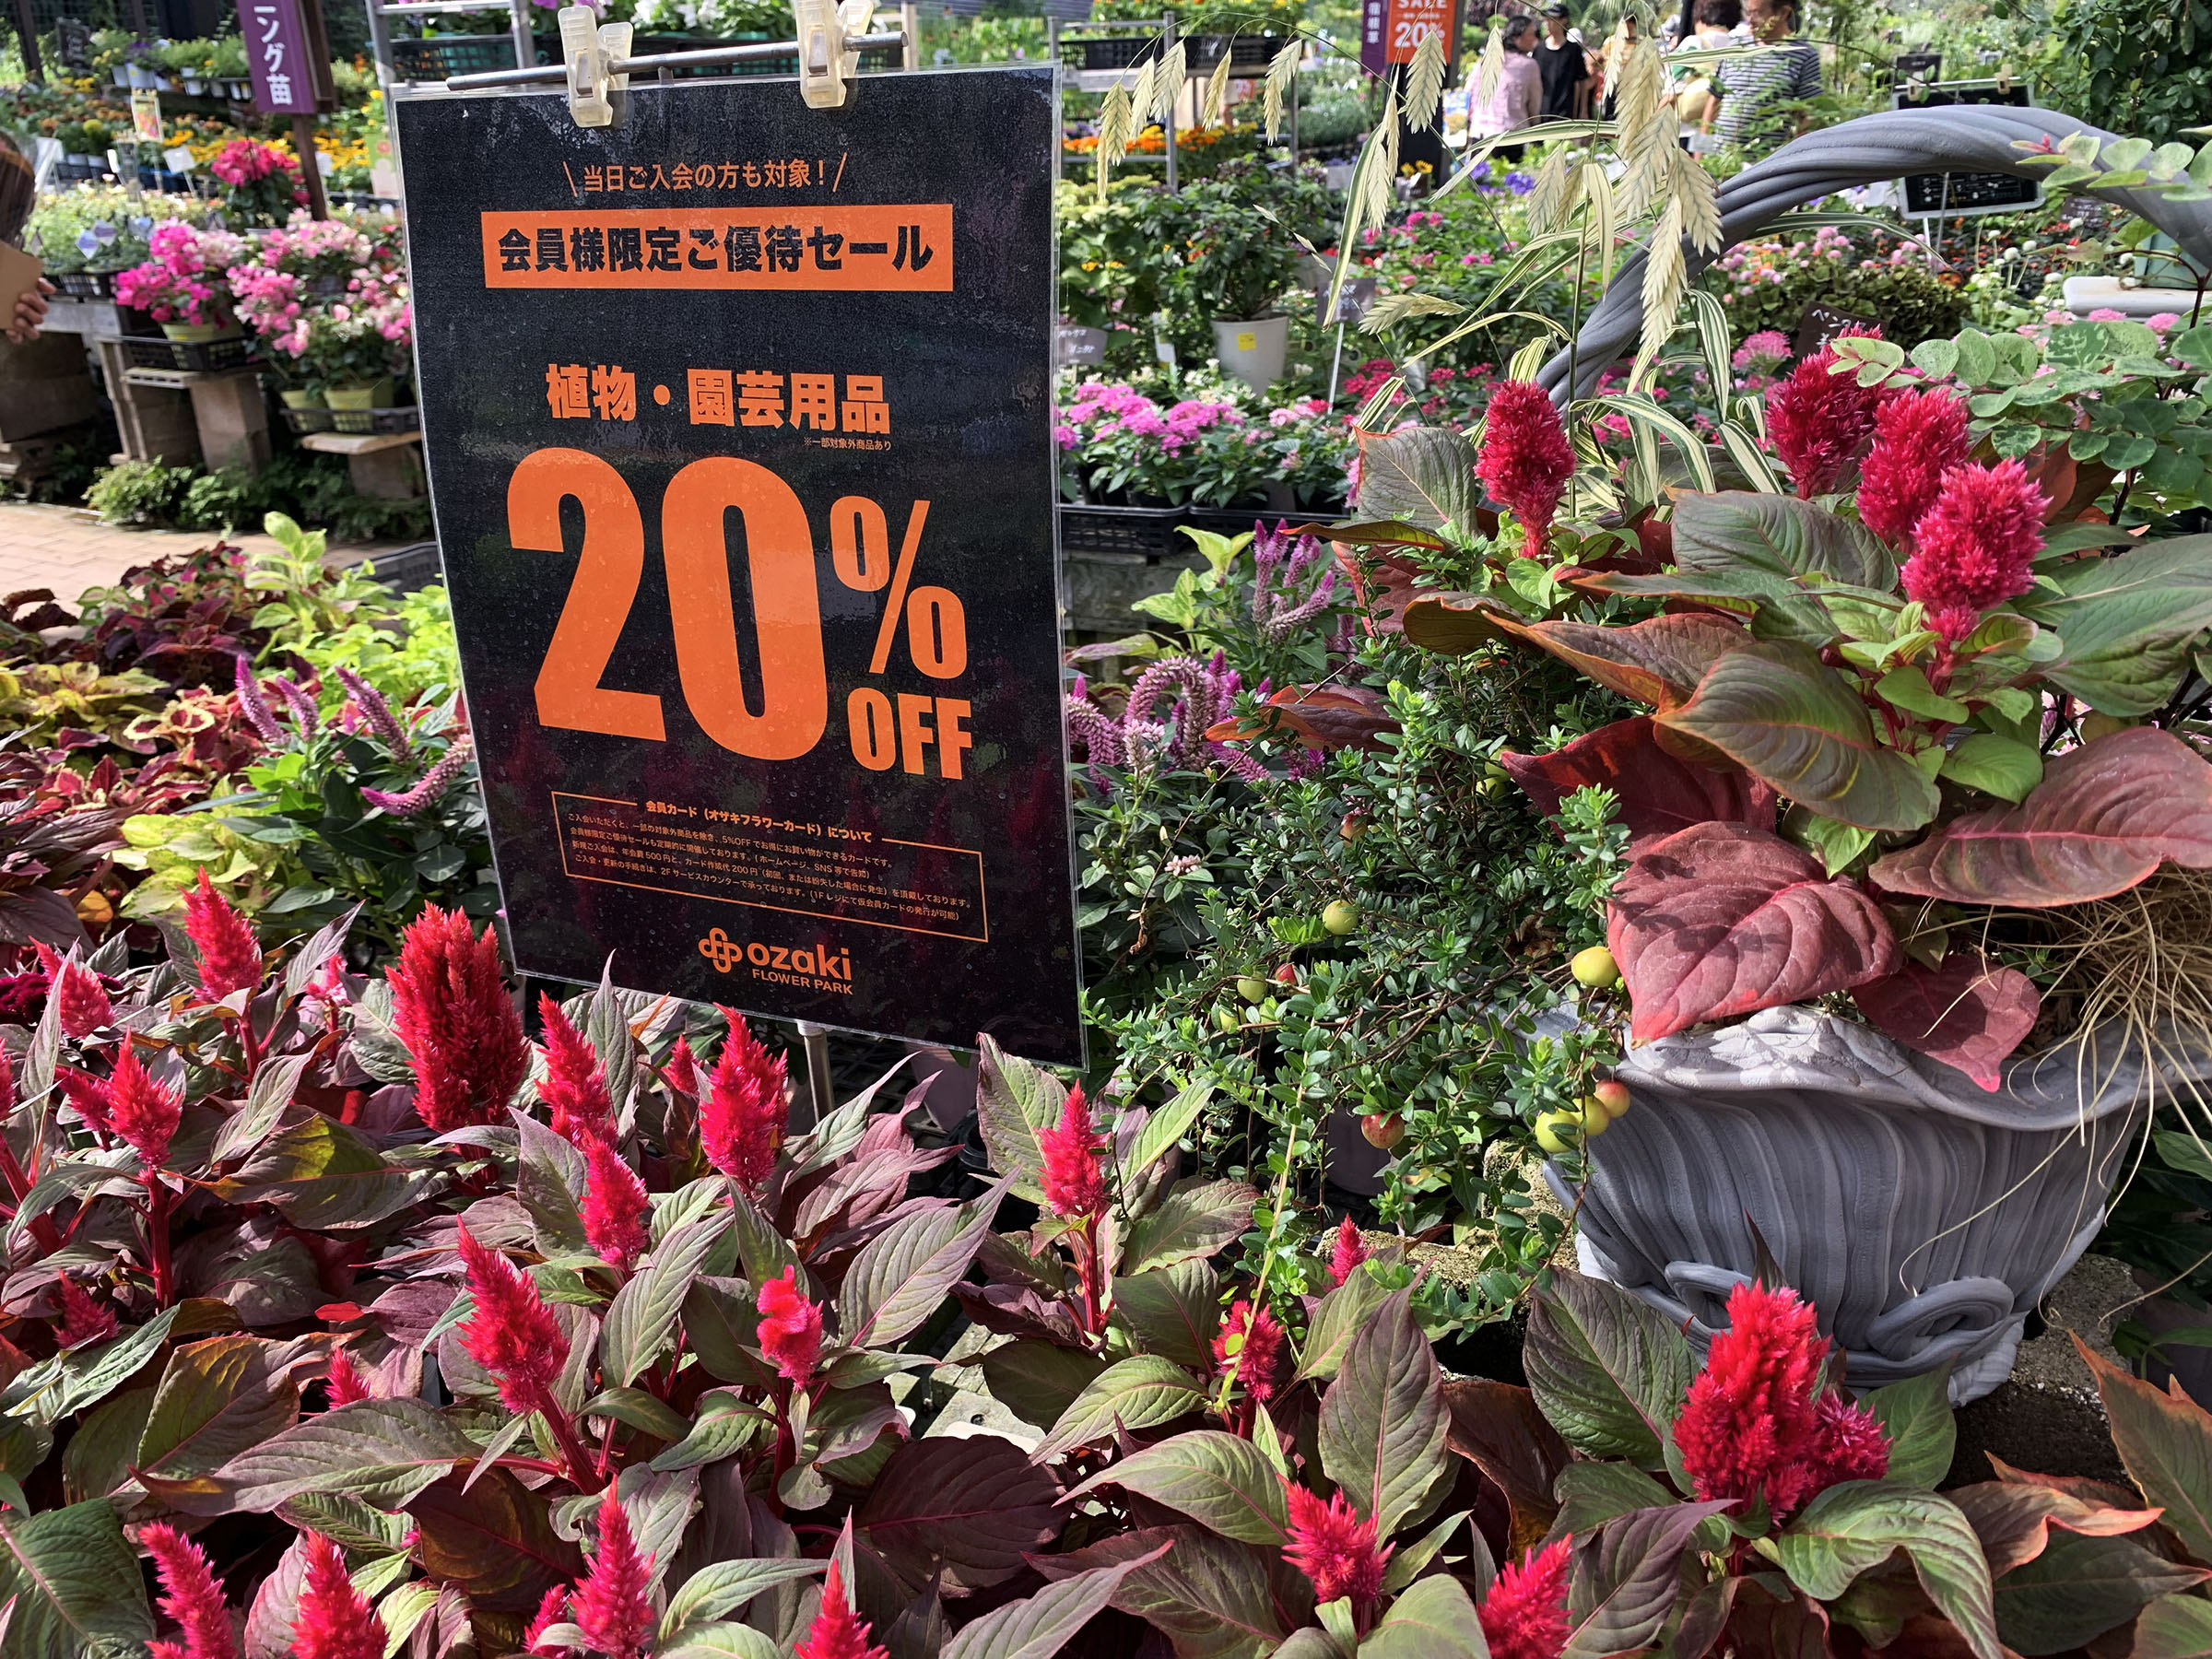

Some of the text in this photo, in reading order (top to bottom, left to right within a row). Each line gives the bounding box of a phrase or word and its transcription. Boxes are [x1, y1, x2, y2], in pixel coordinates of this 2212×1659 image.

[499, 224, 934, 273] 会員様限定ご優待セール
[546, 363, 890, 434] 植物・園芸用品
[507, 447, 972, 780] 20% OFF
[747, 942, 852, 981] ozaki
[752, 968, 854, 996] FLOWER PARK
